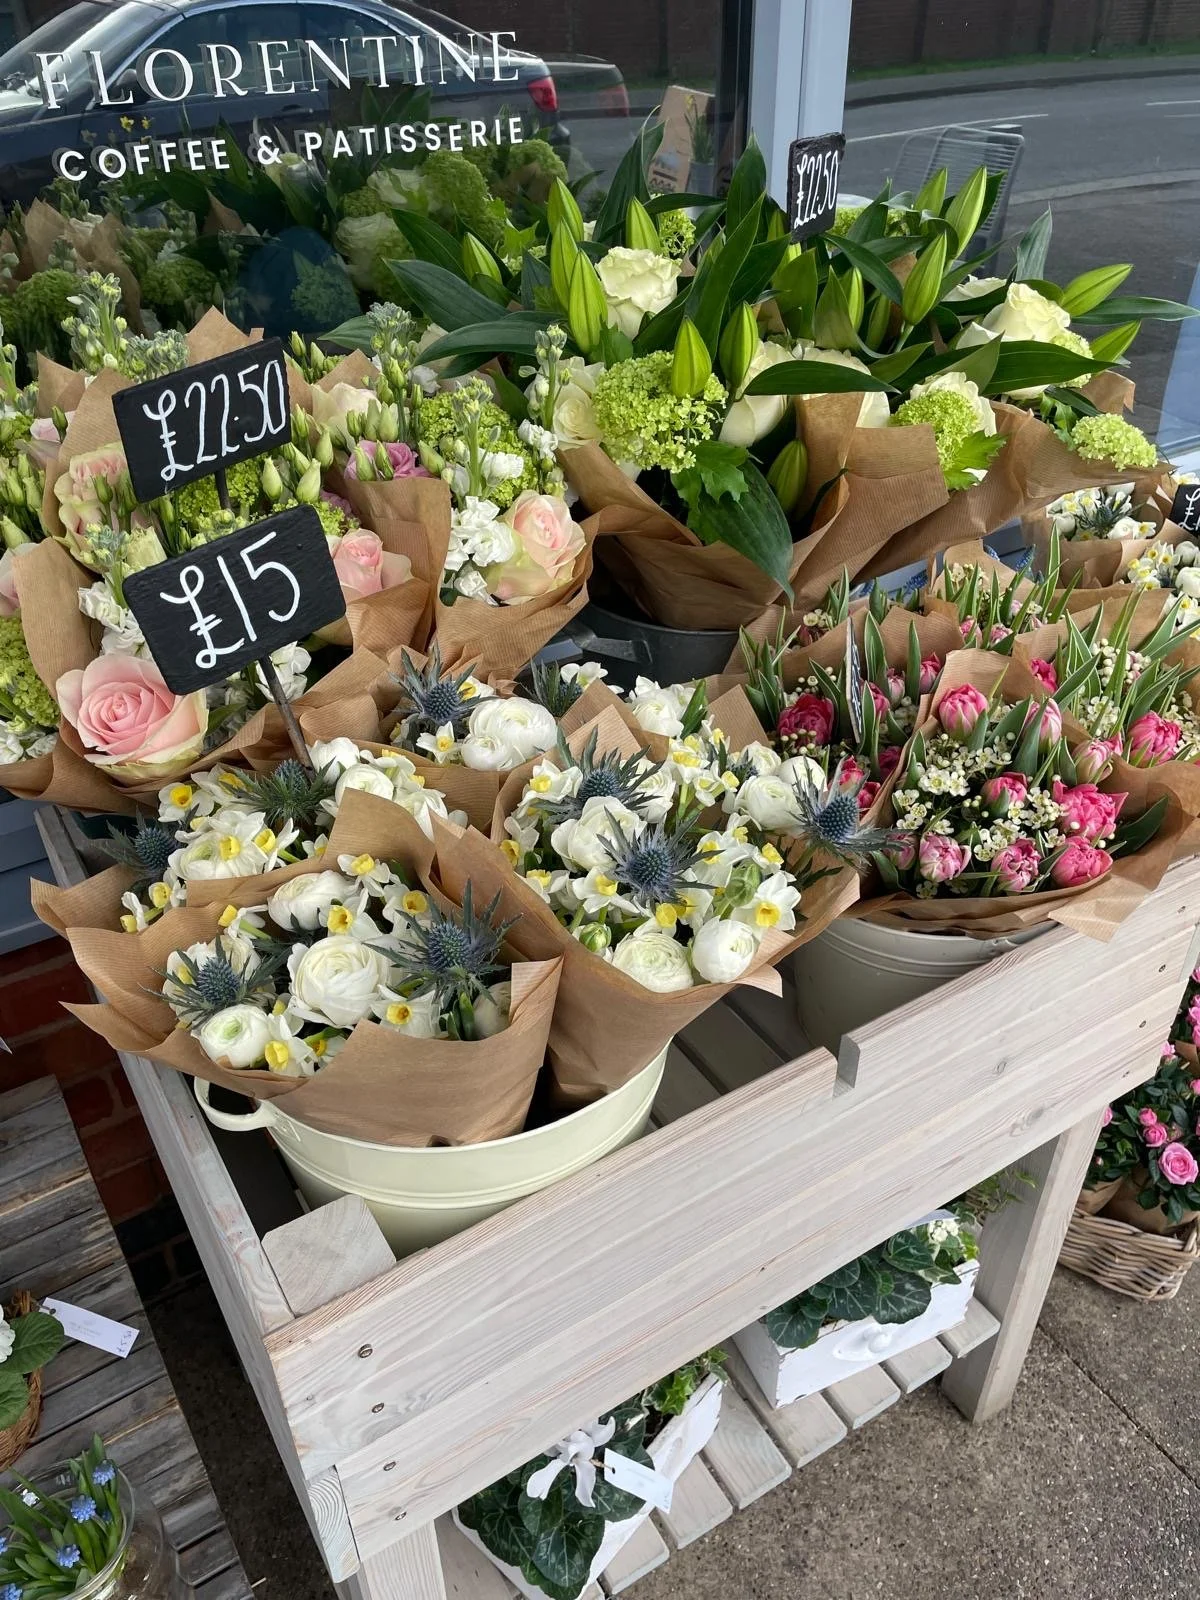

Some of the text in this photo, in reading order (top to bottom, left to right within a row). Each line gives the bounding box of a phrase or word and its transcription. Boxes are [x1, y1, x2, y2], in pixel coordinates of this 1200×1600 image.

[36, 31, 520, 109] FLORENTINE
[59, 117, 523, 181] COFFEE & PATISSERIE
[794, 150, 838, 229] £22.50
[143, 359, 287, 481] £22.50
[160, 532, 300, 668] £15
